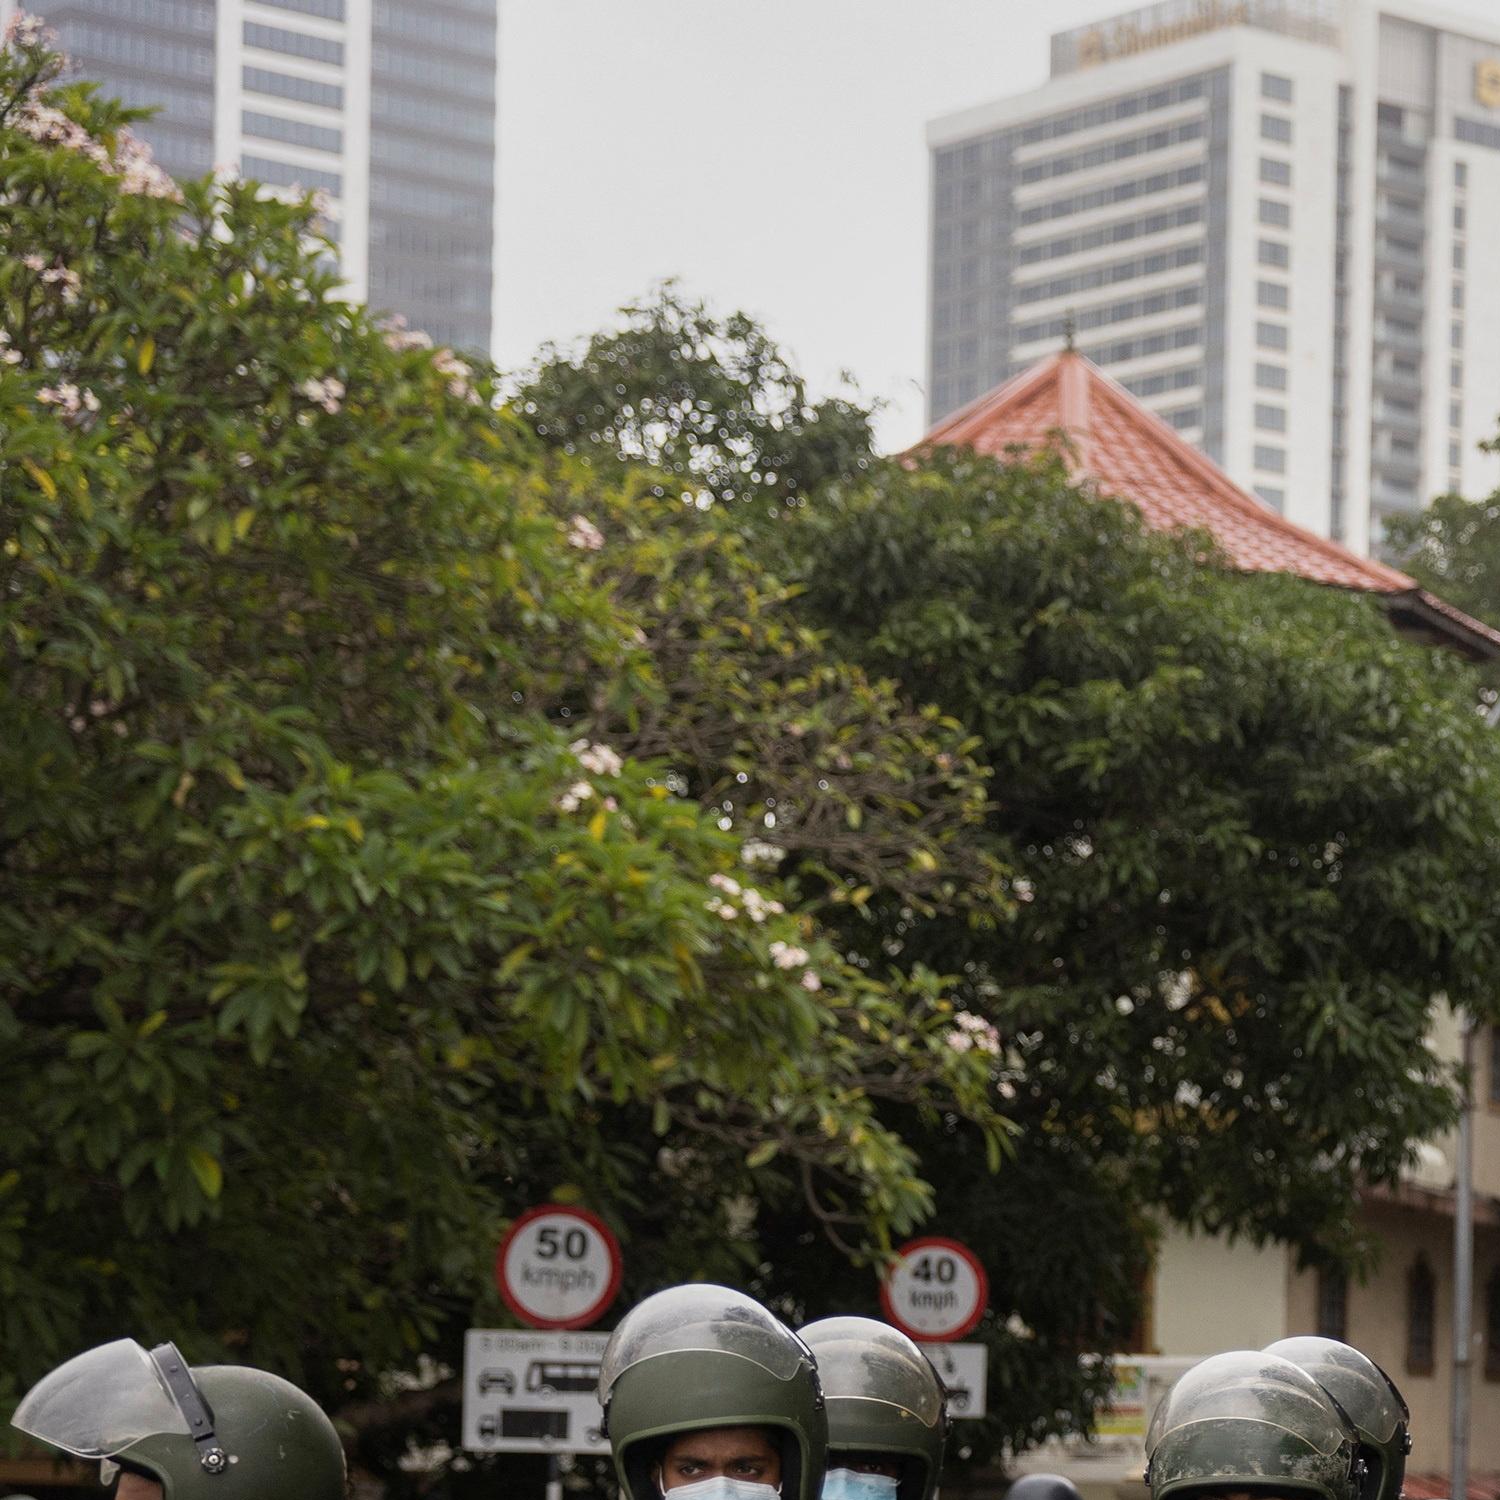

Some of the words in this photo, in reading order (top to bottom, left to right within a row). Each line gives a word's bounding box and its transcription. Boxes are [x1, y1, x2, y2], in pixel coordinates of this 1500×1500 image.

[536, 1226, 588, 1260] 50
[521, 1260, 596, 1294] kmph
[912, 1255, 956, 1284] 40
